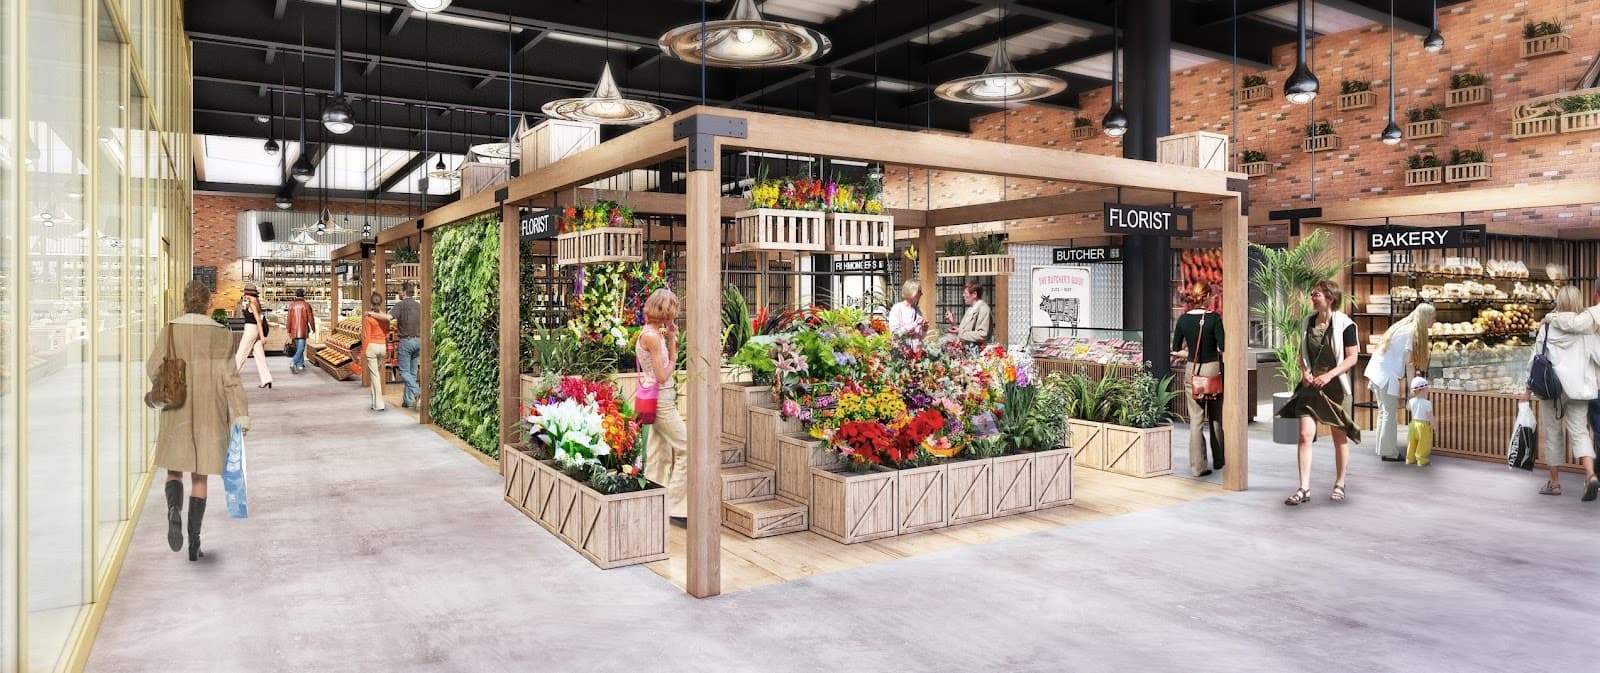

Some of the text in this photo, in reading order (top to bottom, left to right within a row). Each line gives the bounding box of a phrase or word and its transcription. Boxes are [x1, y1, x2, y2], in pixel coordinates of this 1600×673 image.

[521, 214, 549, 236] FLORIST
[1109, 207, 1171, 230] FLORIST
[1372, 230, 1448, 247] BAKERY
[1056, 248, 1104, 261] BUTCHER
